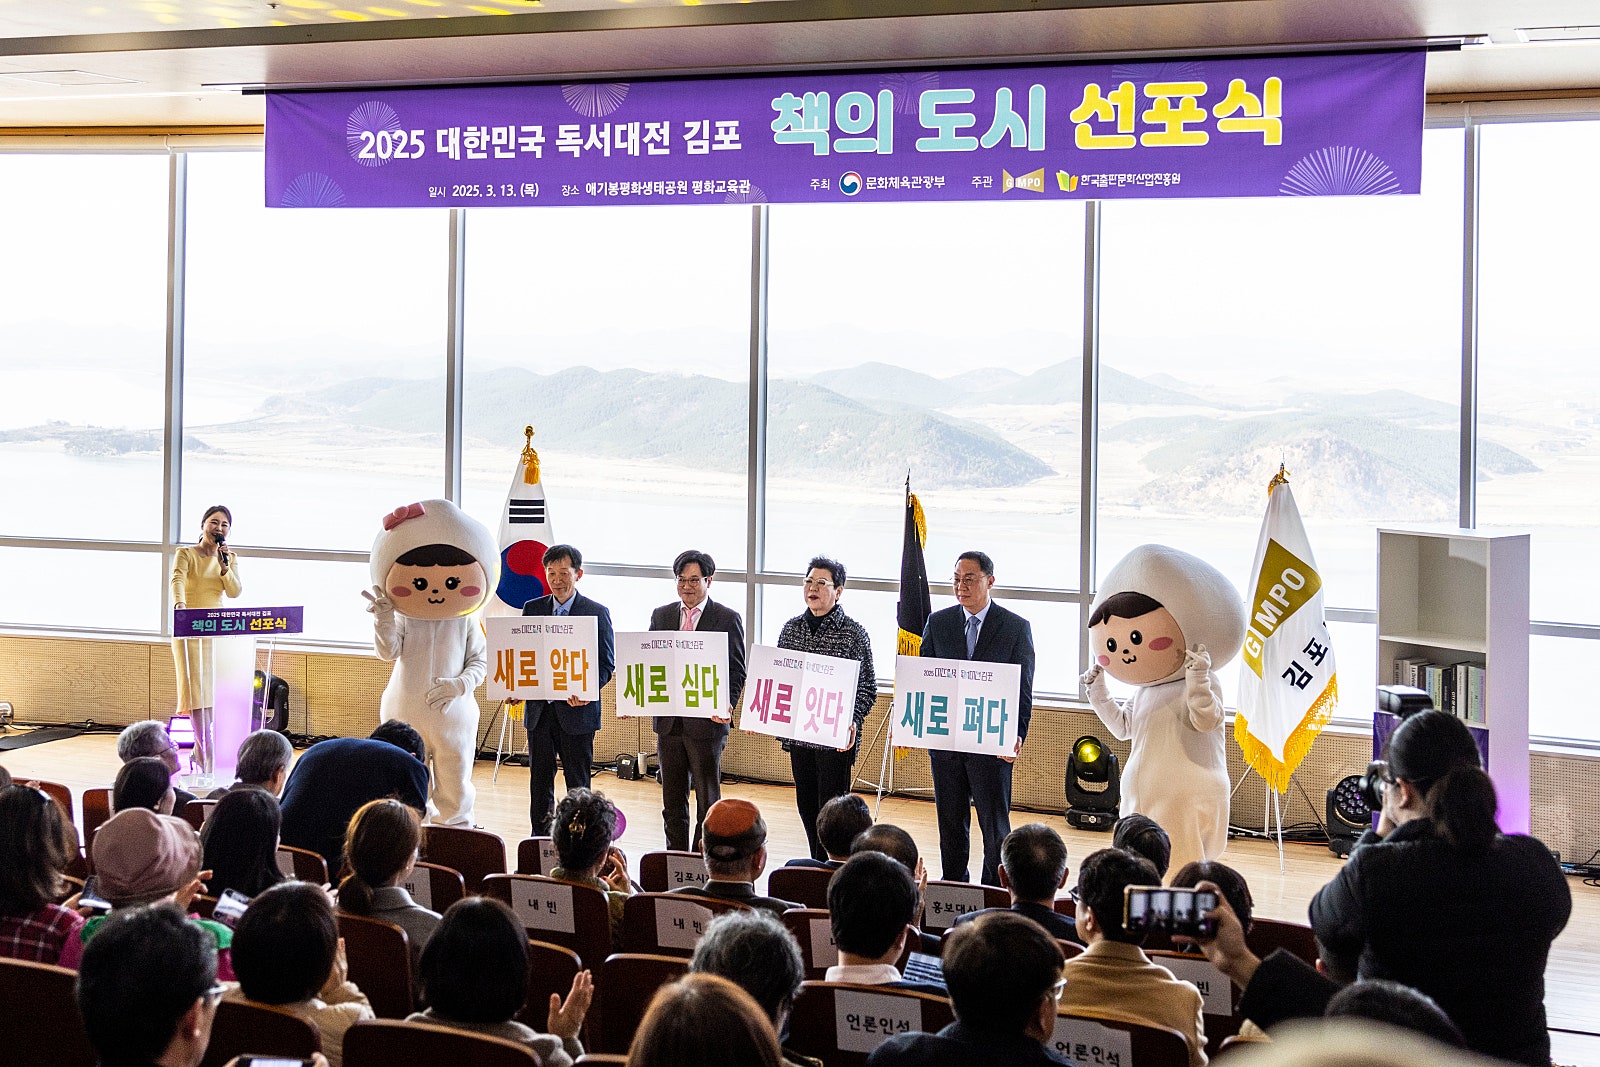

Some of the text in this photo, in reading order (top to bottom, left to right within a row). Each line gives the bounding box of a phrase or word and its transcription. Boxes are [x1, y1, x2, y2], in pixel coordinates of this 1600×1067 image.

[770, 76, 1283, 156] 책의 도시 선포식
[358, 119, 742, 161] 2025 대한민국 독서대전 김포
[428, 182, 539, 198] 일시 2025. 3. 13. (목)
[561, 179, 751, 197] 장소 애기봉평화생태공원 평화교육관
[809, 175, 946, 191] 주최 문화체육관광부
[971, 175, 1041, 189] 주관 GIMPO
[1080, 172, 1181, 188] 한국출판문화산업진흥원
[191, 617, 287, 632] 책의 도시 선포식
[1245, 567, 1306, 659] GIMPO
[493, 648, 589, 692] 새로 알다
[1281, 636, 1329, 691] 김포
[623, 663, 720, 710] 새로 심다
[749, 678, 844, 738] 새로 잇다
[900, 691, 1009, 747] 새로 펴다
